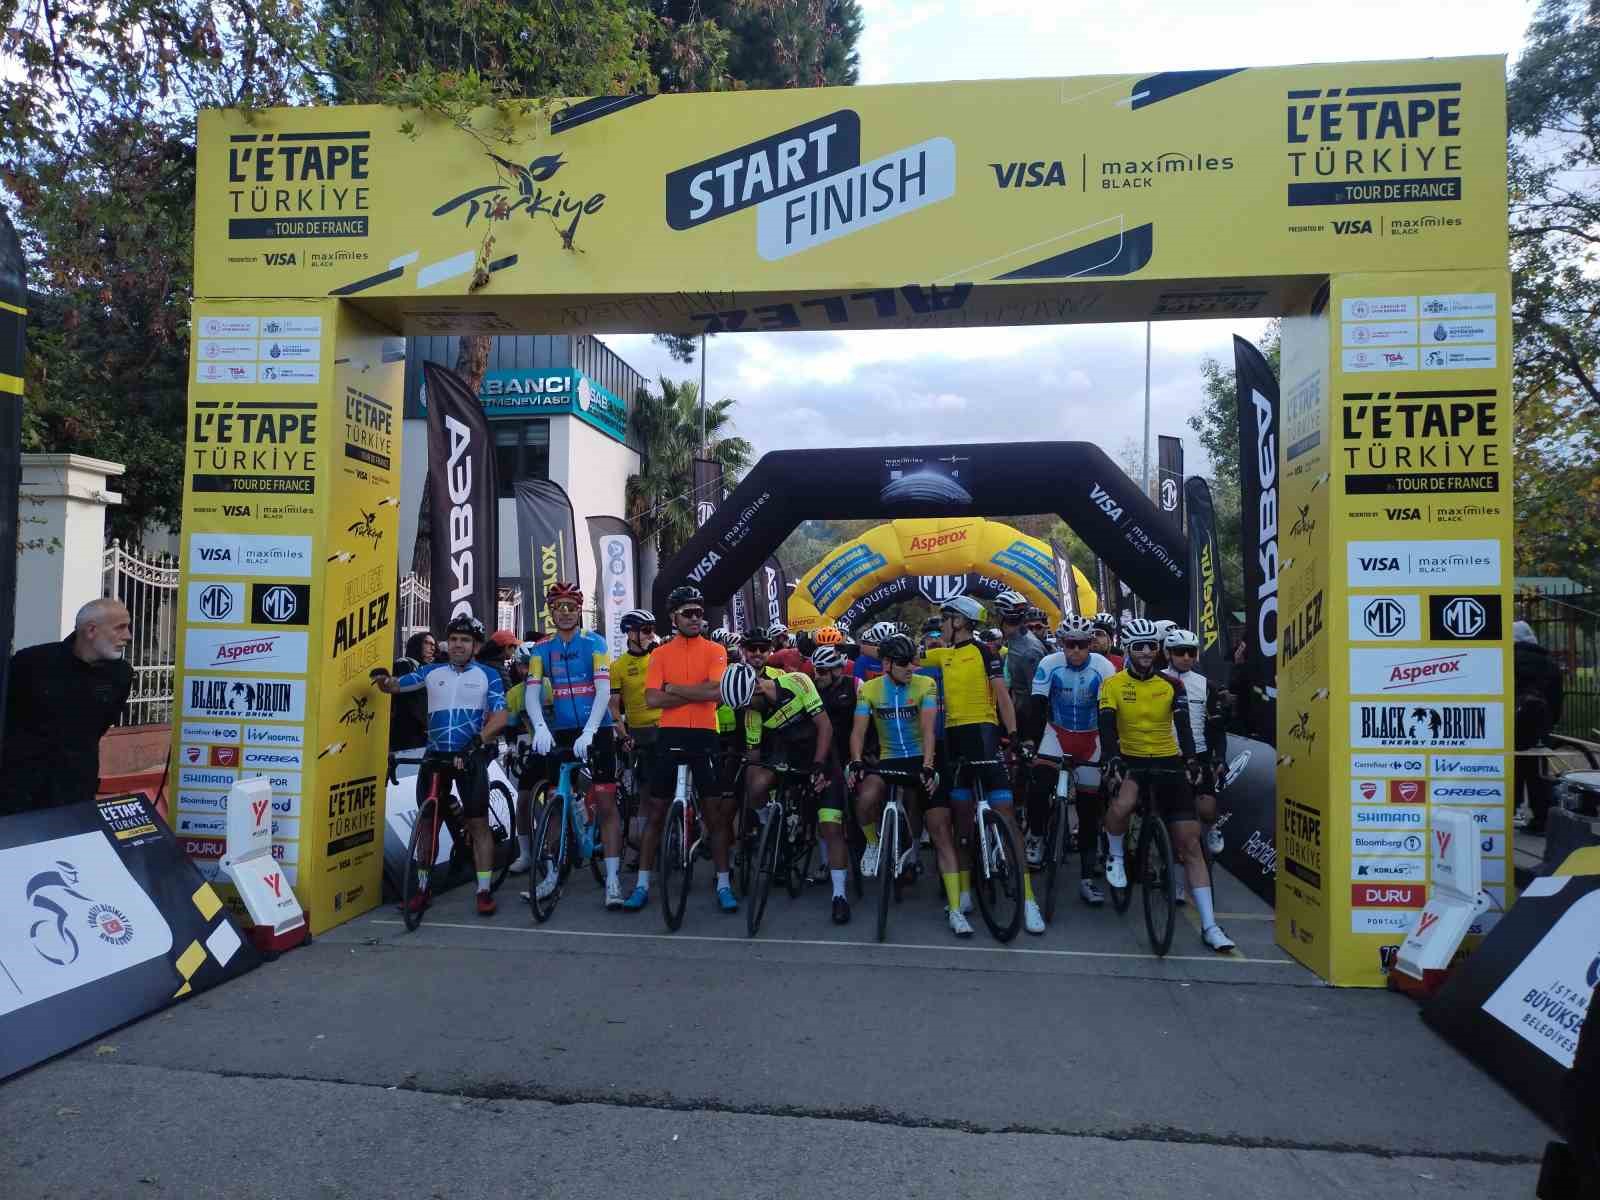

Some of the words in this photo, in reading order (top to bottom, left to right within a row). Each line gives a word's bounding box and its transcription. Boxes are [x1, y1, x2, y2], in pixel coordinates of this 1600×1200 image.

[1102, 152, 1234, 174] maximiles
[1288, 144, 1462, 176] TÜRKİYE
[689, 122, 837, 220] START
[988, 161, 1066, 188] VISA
[1102, 177, 1153, 188] BLACK
[229, 185, 369, 213] TÜRKİYE
[785, 151, 926, 245] FINISH
[1345, 186, 1382, 200] TOUR
[1383, 185, 1401, 199] DE
[1403, 183, 1455, 198] FRANCE
[275, 221, 304, 237] TOUR
[306, 221, 320, 236] DE
[322, 220, 364, 235] FRANCE
[1330, 220, 1373, 235] VISA
[1391, 216, 1462, 228] maximiles
[264, 253, 297, 266] VISA
[311, 250, 369, 262] maximiles
[345, 424, 392, 454] TÜRKİYE
[193, 446, 316, 471] TÜRKİYE
[1344, 441, 1499, 468] TÜRKİYE
[232, 479, 257, 490] TOUR
[259, 479, 272, 490] DE
[273, 480, 311, 492] FRANCE
[1396, 479, 1427, 490] TOUR
[1430, 478, 1445, 490] DE
[1447, 477, 1494, 489] FRANCE
[223, 506, 251, 517] VISA
[1384, 508, 1421, 521] VISA
[1437, 506, 1500, 516] maximiles
[688, 550, 722, 583] VISA
[724, 492, 771, 542] maximiles
[1088, 482, 1123, 522] VISA
[1131, 526, 1184, 579] maximiles
[910, 529, 967, 551] Asperox
[198, 548, 231, 560] VISA
[246, 547, 304, 558] maximiles
[1418, 555, 1491, 566] maximiles
[1357, 557, 1400, 571] VISA
[201, 586, 231, 618] MG
[857, 577, 909, 613] yourself
[264, 588, 295, 620] MG
[333, 593, 389, 658] ALLEZ
[1365, 600, 1404, 636] MG
[1444, 599, 1485, 636] MG
[1282, 590, 1323, 667] ALLEZ
[216, 641, 273, 660] Asperox
[1390, 659, 1460, 682] Asperox
[191, 680, 228, 710] BLACK
[256, 682, 291, 712] BRUIN
[1361, 706, 1406, 739] BLACK
[1443, 706, 1486, 739] BRUIN
[267, 735, 300, 743] HOSPITAL
[245, 754, 300, 764] ORBEA
[1459, 764, 1500, 773] HOSPITAL
[183, 774, 233, 784] SHIMANO
[1433, 787, 1502, 797] ORBEA
[108, 815, 153, 831] TÜRKİYE
[328, 811, 376, 837] TÜRKİYE
[1357, 812, 1421, 823] SHIMANO
[186, 842, 223, 855] DURU
[1355, 837, 1402, 849] Bloomberg
[1366, 889, 1411, 902] DURU
[1522, 1013, 1577, 1053] BELEDİYES
